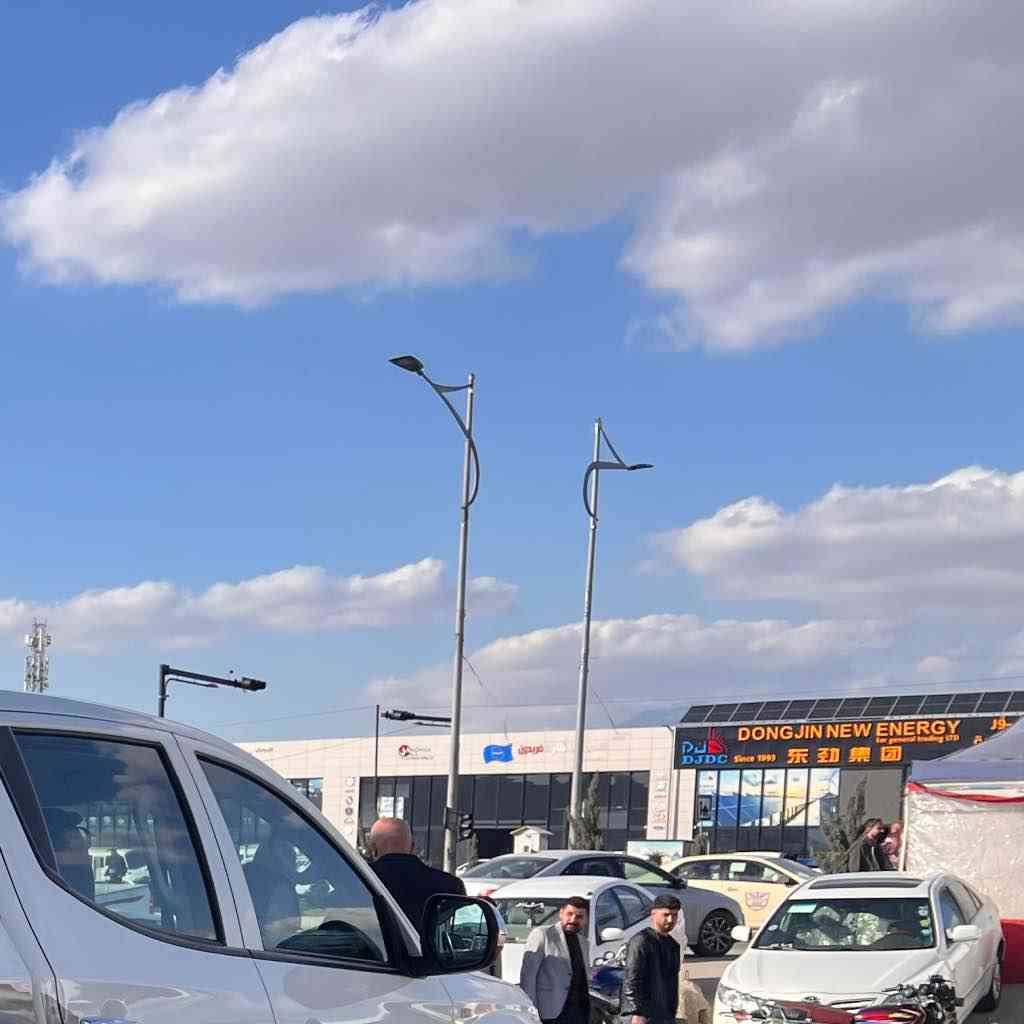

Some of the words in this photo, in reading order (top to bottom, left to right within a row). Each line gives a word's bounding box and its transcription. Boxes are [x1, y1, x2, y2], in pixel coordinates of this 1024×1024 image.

[737, 724, 823, 741] DONGJIN
[826, 723, 872, 739] NEW
[876, 720, 961, 737] ENERGY
[682, 754, 728, 765] DJDC
[734, 754, 755, 763] Since
